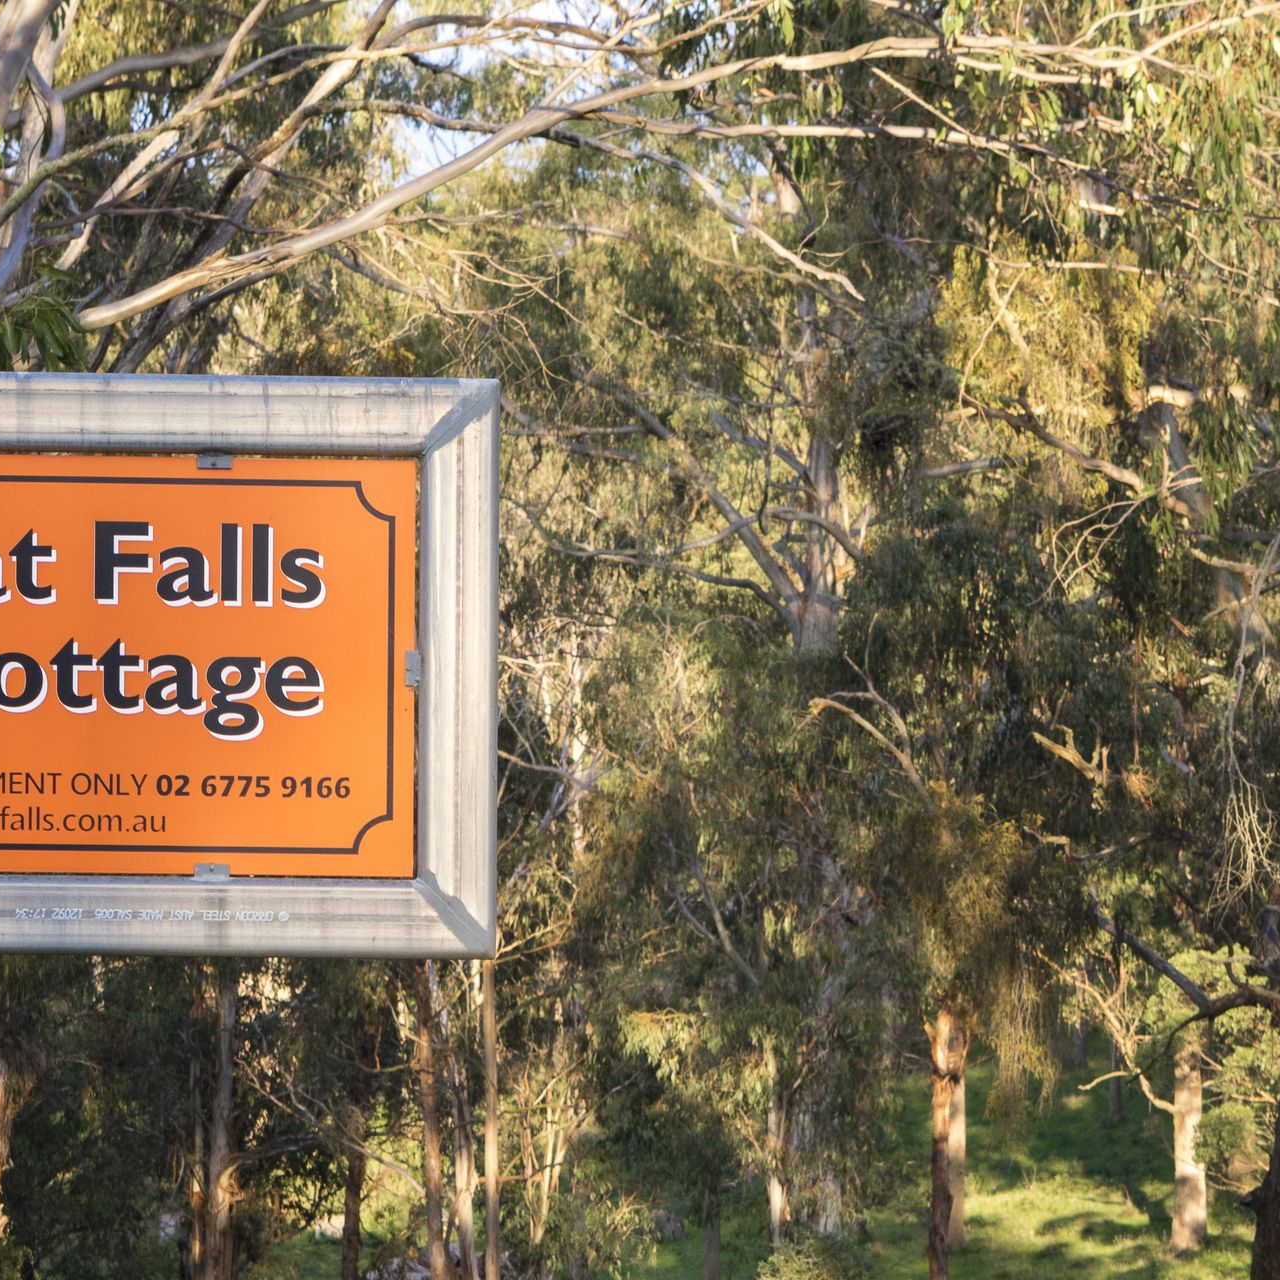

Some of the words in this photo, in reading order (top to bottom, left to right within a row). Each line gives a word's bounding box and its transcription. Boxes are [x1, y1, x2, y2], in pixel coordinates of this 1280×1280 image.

[94, 520, 327, 609] Falls
[70, 772, 148, 797] ONLY
[155, 773, 191, 797] 02
[200, 774, 272, 798] 6775
[280, 776, 352, 799] 9166
[138, 908, 164, 920] MADE
[200, 909, 232, 921] STEEL
